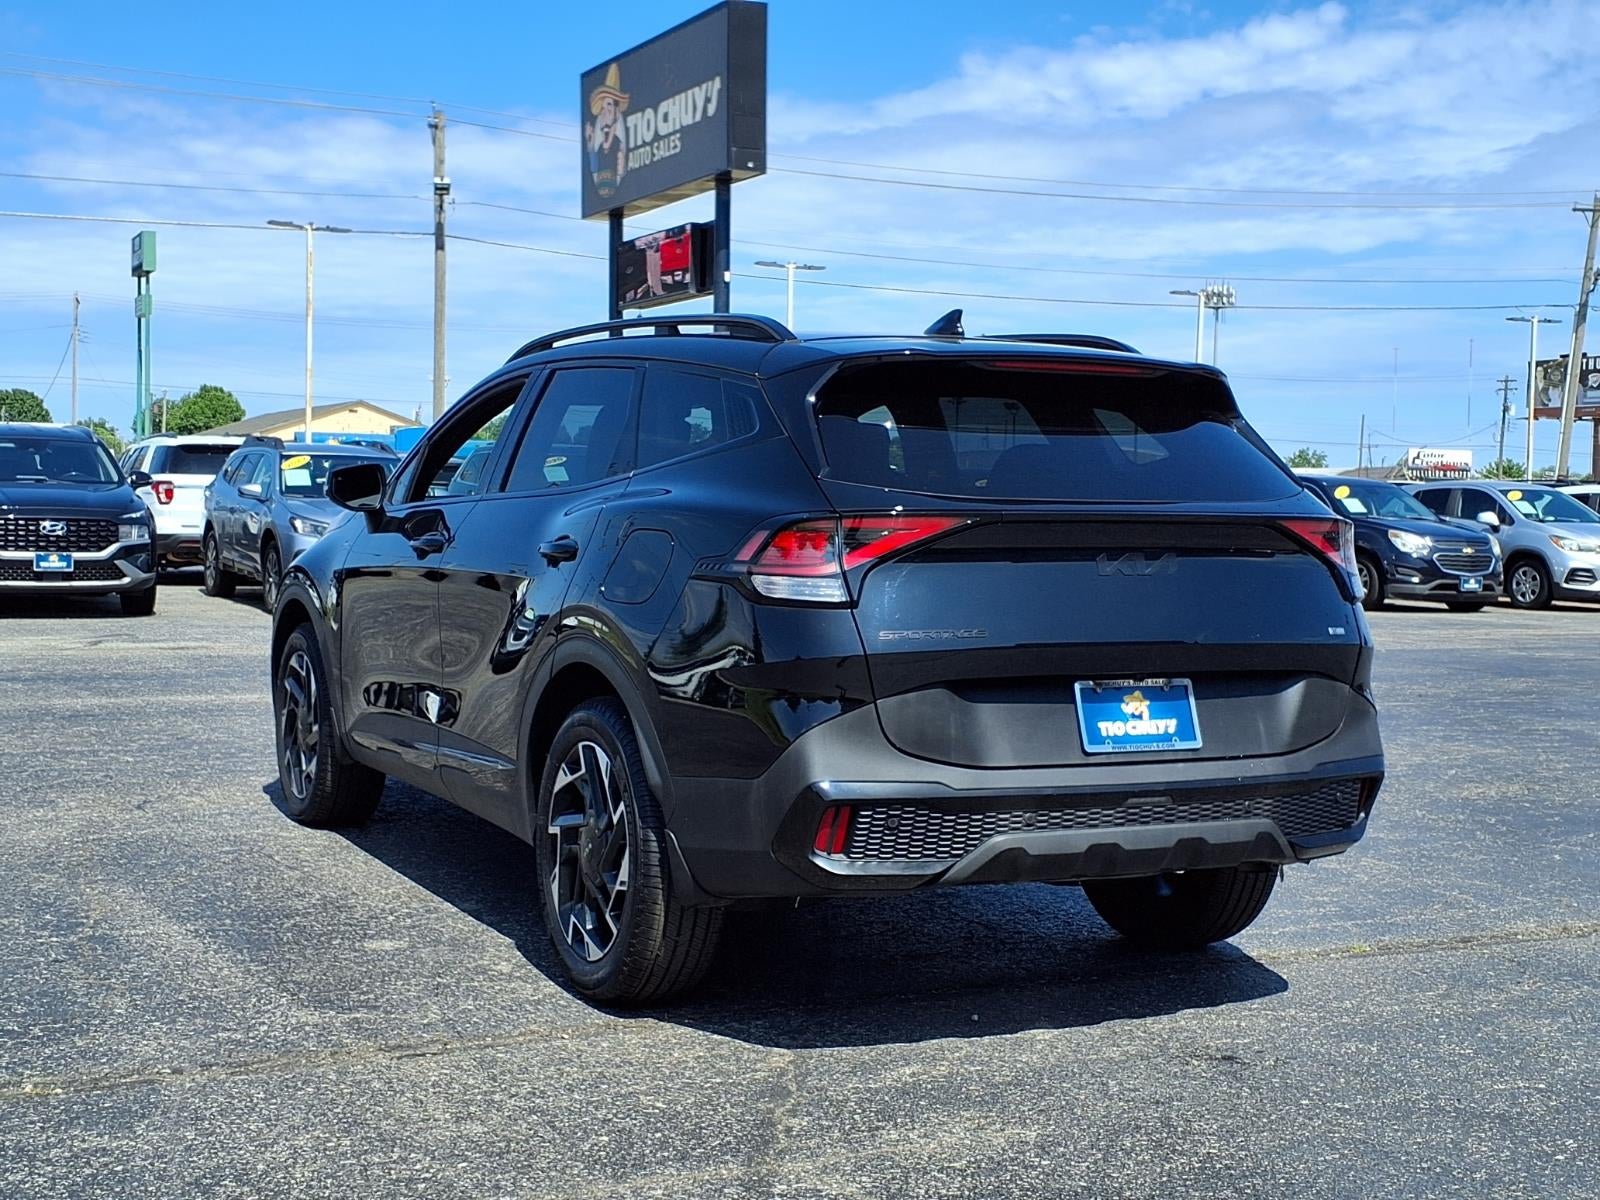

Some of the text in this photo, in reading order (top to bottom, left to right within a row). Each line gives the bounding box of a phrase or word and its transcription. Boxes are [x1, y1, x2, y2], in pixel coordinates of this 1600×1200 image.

[626, 76, 722, 149] TIO CHUY'S
[627, 133, 682, 171] AUTO SALES
[878, 629, 988, 641] SPORTAGE
[1097, 720, 1126, 737] TIO
